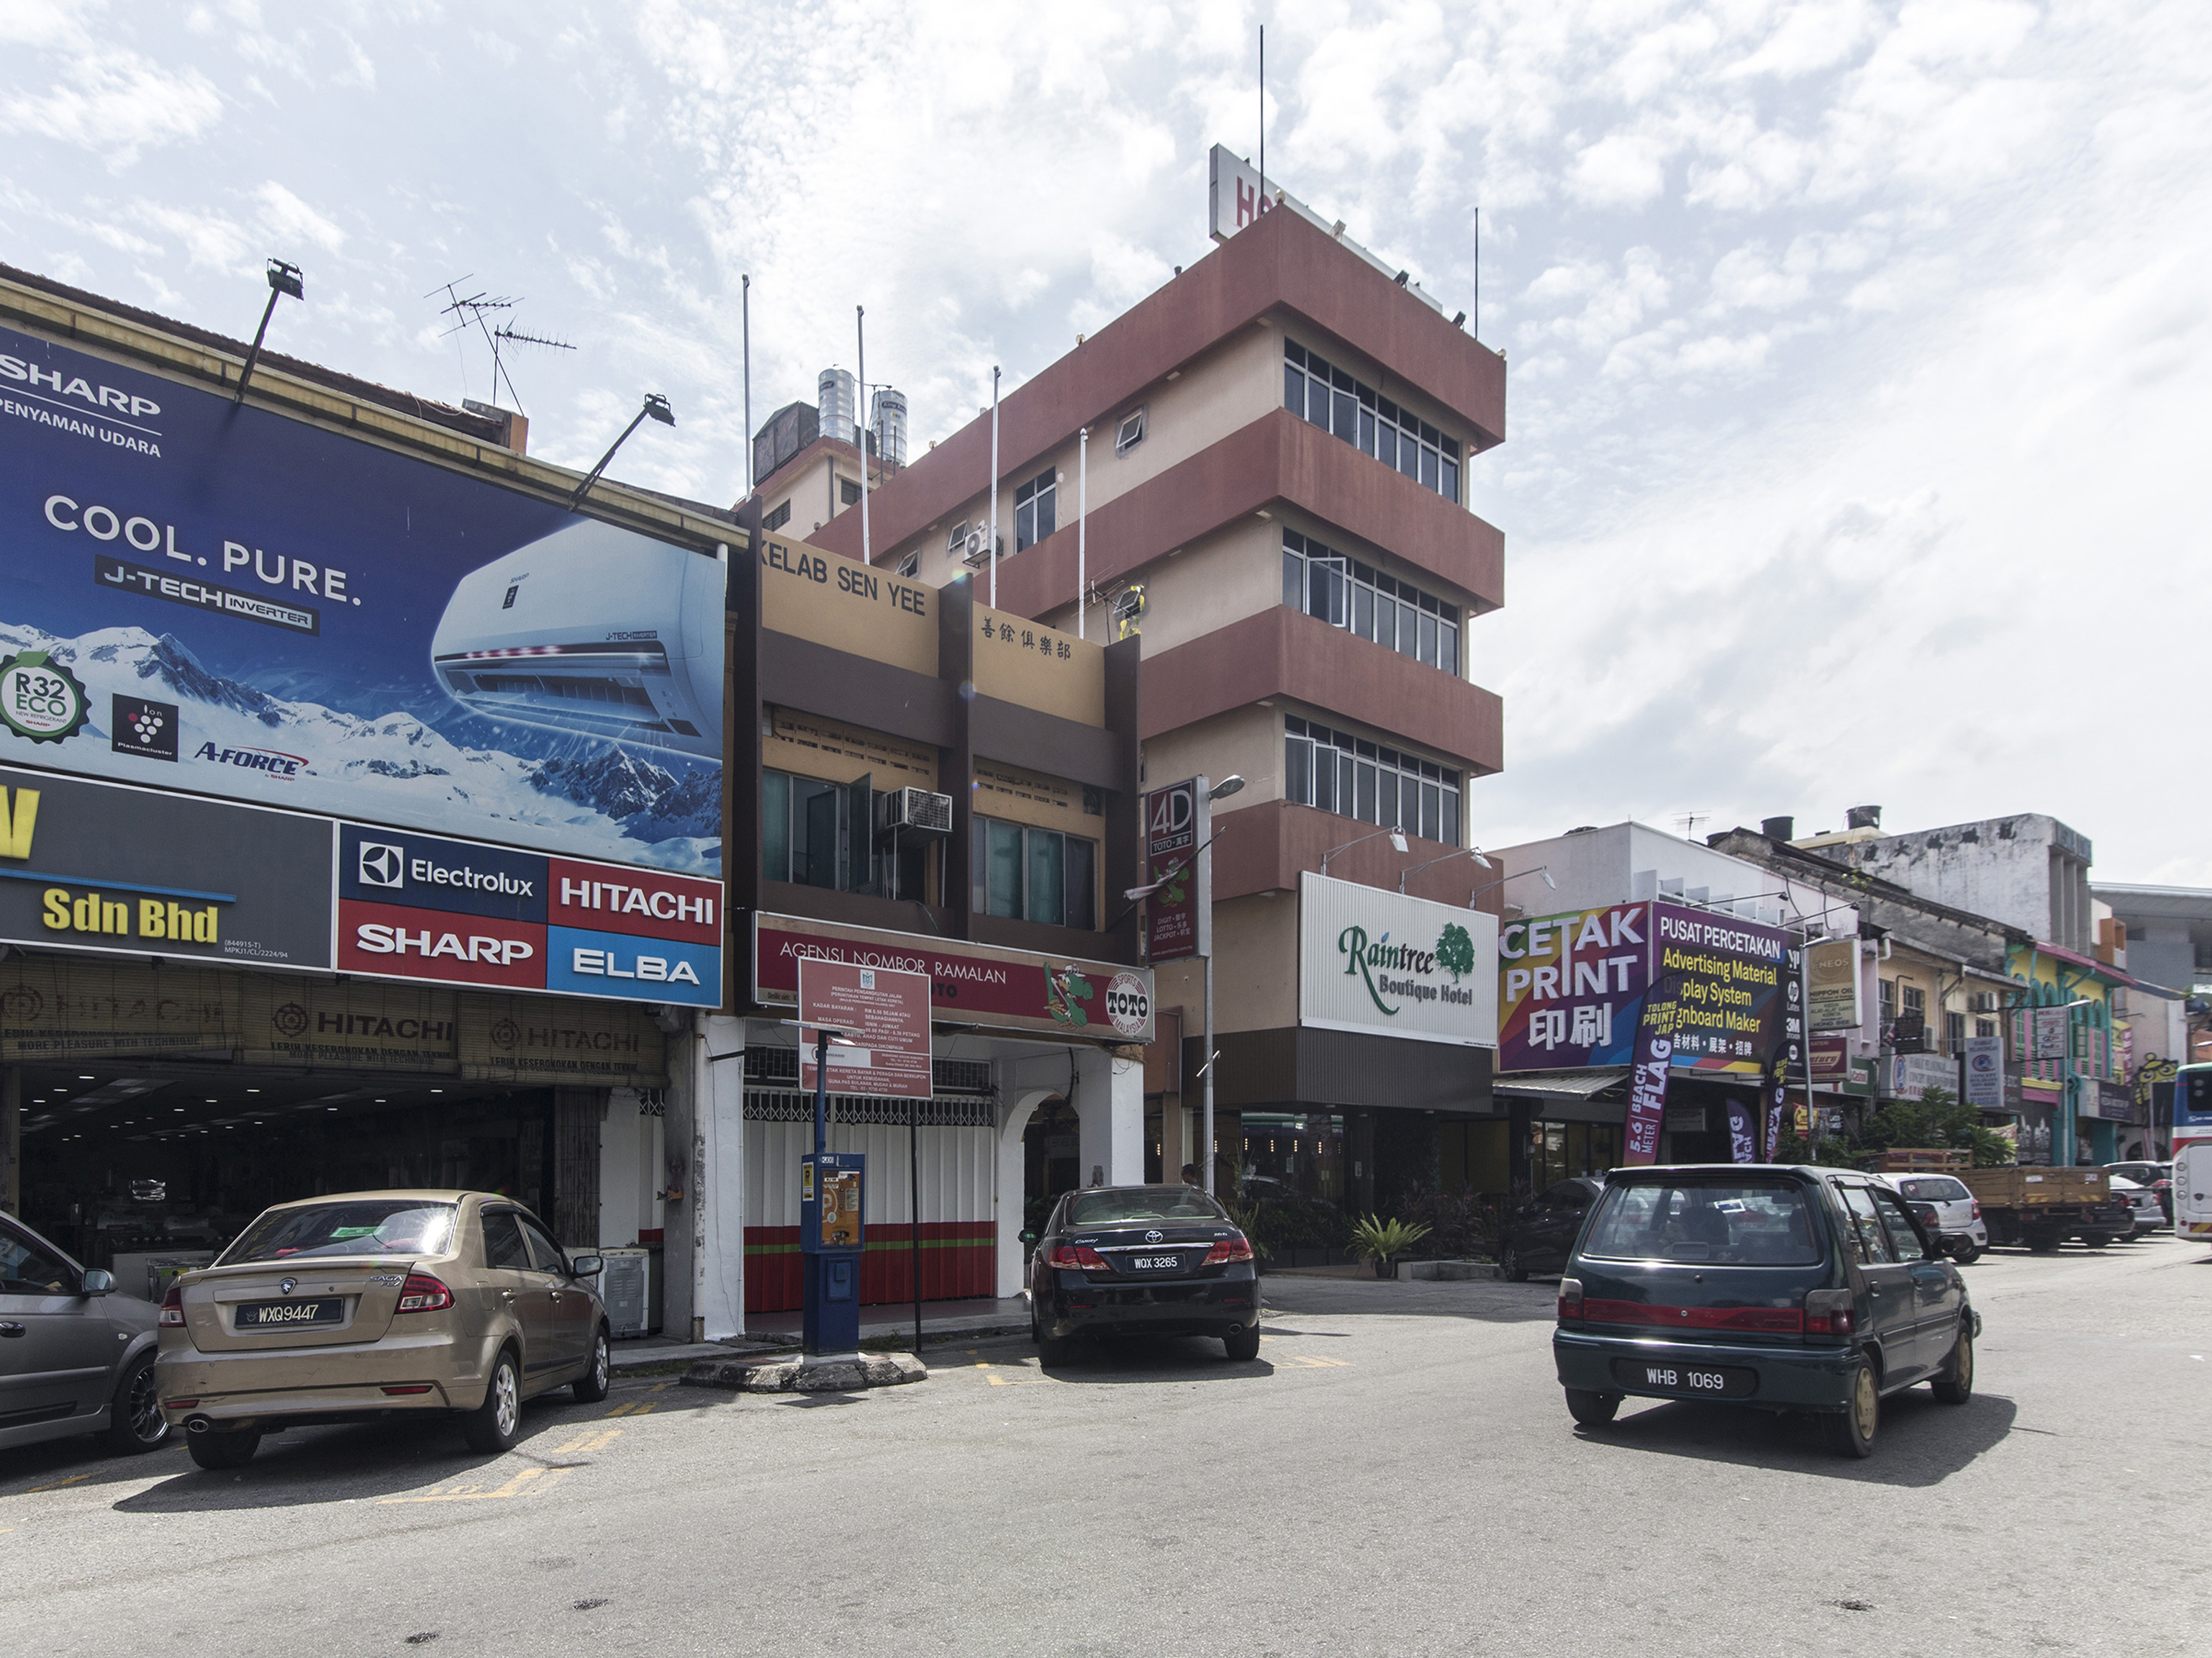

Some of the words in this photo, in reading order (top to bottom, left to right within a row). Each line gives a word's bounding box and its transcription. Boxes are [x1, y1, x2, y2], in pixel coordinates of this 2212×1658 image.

[0, 354, 161, 417] SHARP
[99, 428, 161, 458] UDARA
[45, 494, 207, 566] COOL.
[224, 540, 361, 607] PURE.
[104, 566, 223, 609] J-TECH
[228, 597, 309, 627] INVERTER
[837, 566, 878, 601] SEN
[887, 581, 925, 616] YEE
[16, 672, 65, 700] R32
[16, 693, 67, 717] ECO
[117, 742, 173, 756] Plasmacluster
[194, 741, 299, 776] A-FORCE
[1151, 789, 1193, 835] 4D
[1153, 839, 1172, 852] TOTO
[411, 859, 533, 897] Electrolux
[43, 888, 129, 935] Sdn
[139, 898, 218, 943] Bhd
[561, 876, 714, 925] HITACHI
[357, 923, 534, 966] SHARP
[1499, 907, 1645, 960] CETAK
[1660, 916, 1702, 944] PUSAT
[1705, 925, 1781, 960] PERCETAKAN
[573, 948, 700, 985] ELBA
[779, 941, 844, 963] AGENSI
[853, 950, 926, 974] NOMBOR
[935, 961, 1007, 985] RAMALAN
[1338, 925, 1434, 1015] Raintree
[1507, 955, 1638, 1002] PRINT
[1663, 947, 1731, 983] Advertising
[1733, 959, 1778, 986] Material
[1107, 991, 1148, 1018] TOTO
[1379, 974, 1438, 1002] Boutique
[1441, 984, 1473, 1005] Hotel
[1710, 982, 1752, 1007] System
[865, 1014, 904, 1023] SEBAHAGIANNYA
[1643, 1010, 1676, 1026] PRINT
[1646, 1001, 1677, 1013] TOLONG
[1726, 1010, 1761, 1033] Maker
[317, 1011, 453, 1041] HITACHI
[528, 1028, 638, 1052] HITACHI
[1528, 1002, 1613, 1051] 印刷
[1655, 1023, 1674, 1035] JAP
[1786, 1017, 1800, 1033] 3M
[1631, 1064, 1648, 1113] BEACH
[1643, 1039, 1672, 1111] FLAG
[1630, 1120, 1643, 1154] 5.6
[1641, 1123, 1656, 1154] METER
[1153, 1256, 1178, 1268] 3265
[258, 1304, 319, 1323] WXQ9447
[1646, 1368, 1677, 1386] WHB
[1687, 1372, 1724, 1390] 1069
